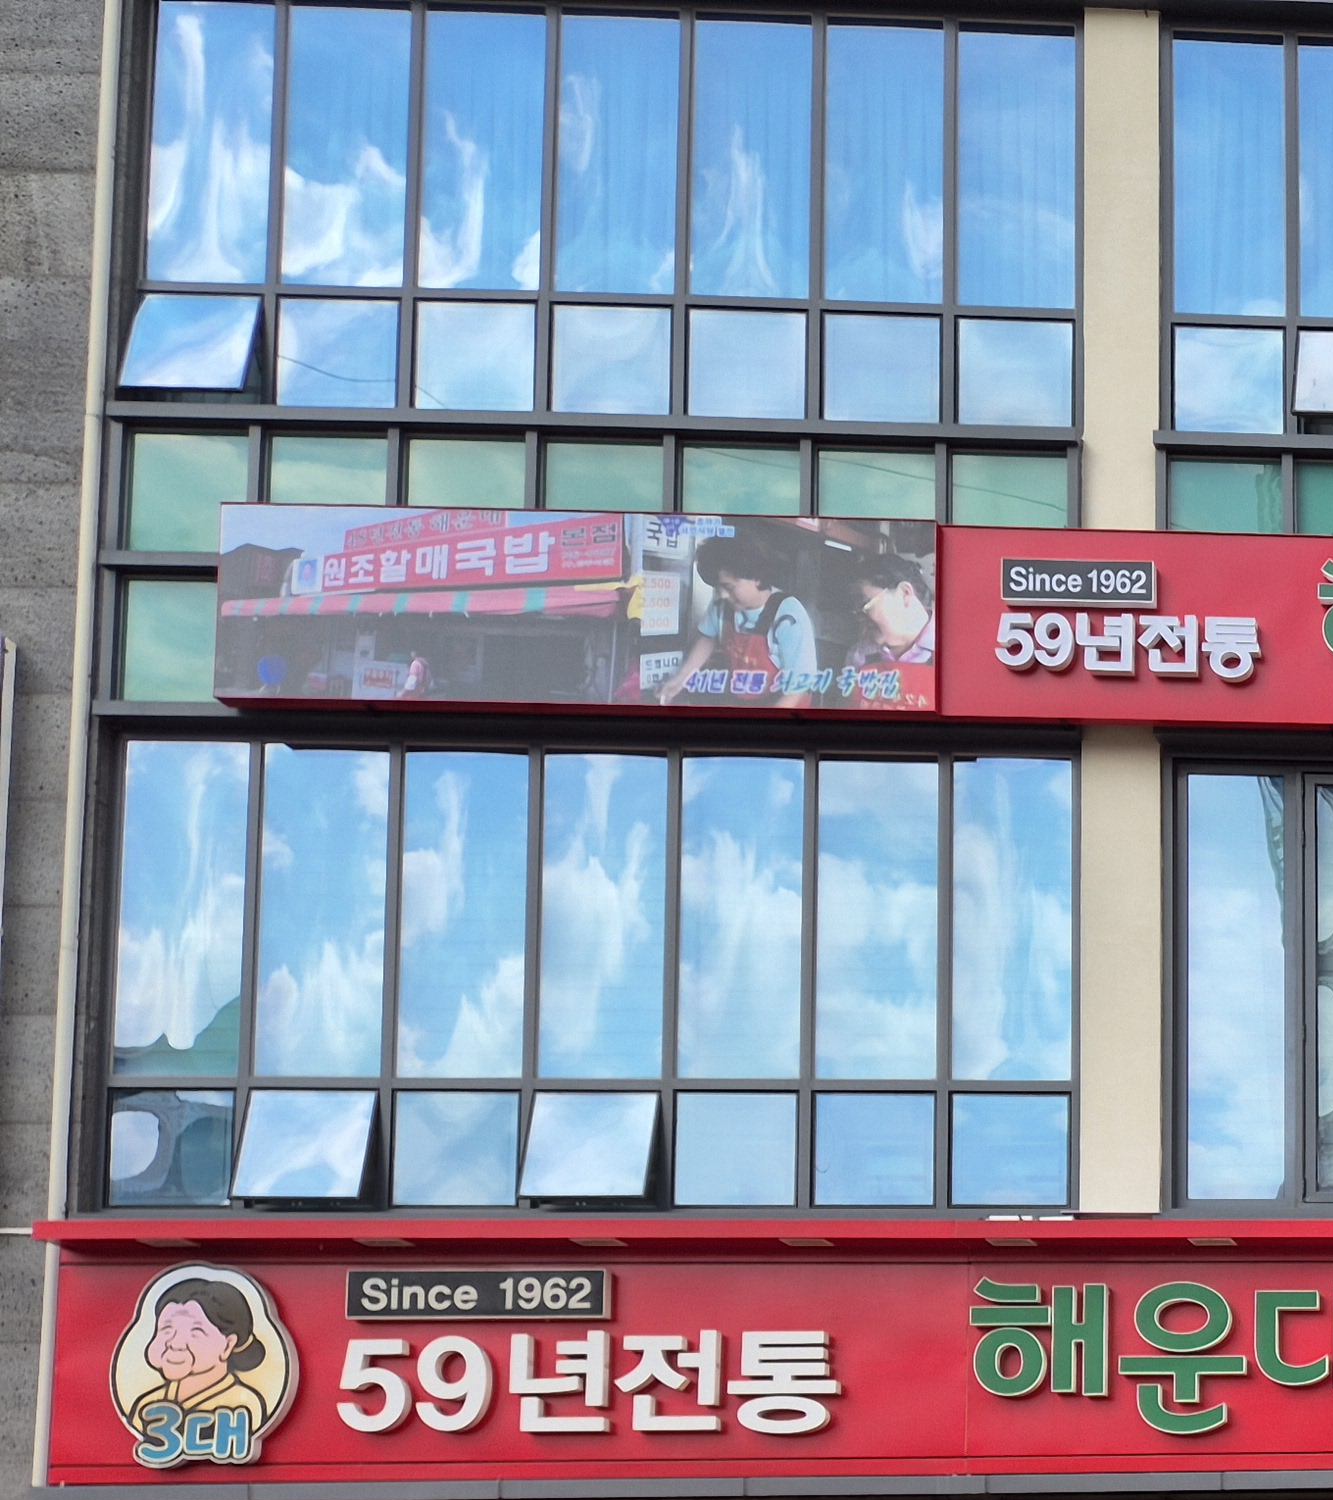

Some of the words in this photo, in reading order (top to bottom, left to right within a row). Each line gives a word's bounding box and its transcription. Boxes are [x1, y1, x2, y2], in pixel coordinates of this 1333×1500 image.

[323, 531, 555, 587] 원조할매국밥
[1009, 564, 1083, 596] Since
[1087, 564, 1147, 596] 1962
[994, 611, 1260, 683] 59년전통
[360, 1277, 479, 1311] Since
[499, 1276, 593, 1310] 1962
[336, 1329, 842, 1434] 59년전통
[136, 1403, 253, 1467] 3대
